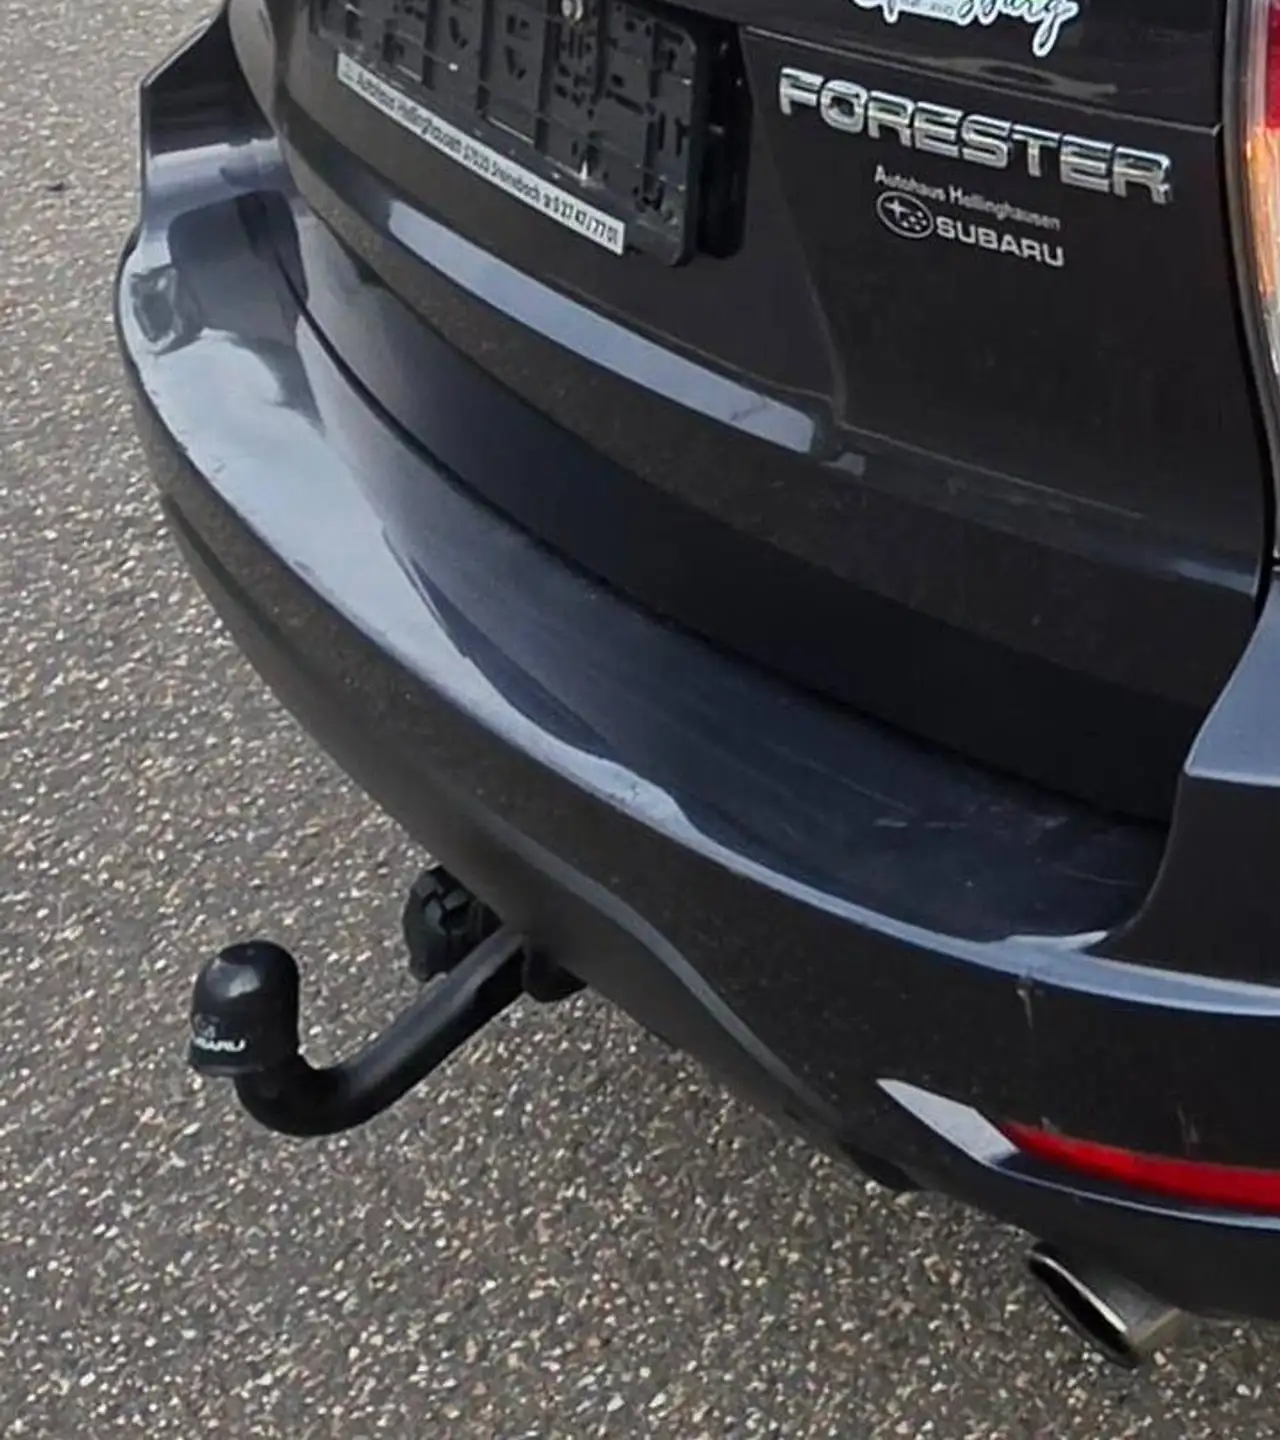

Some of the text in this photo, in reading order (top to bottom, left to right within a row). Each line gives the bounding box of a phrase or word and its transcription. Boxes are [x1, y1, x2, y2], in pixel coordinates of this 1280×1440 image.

[778, 66, 1173, 205] FORESTER
[874, 164, 946, 202] Autohaus
[935, 215, 1065, 267] SUBARU
